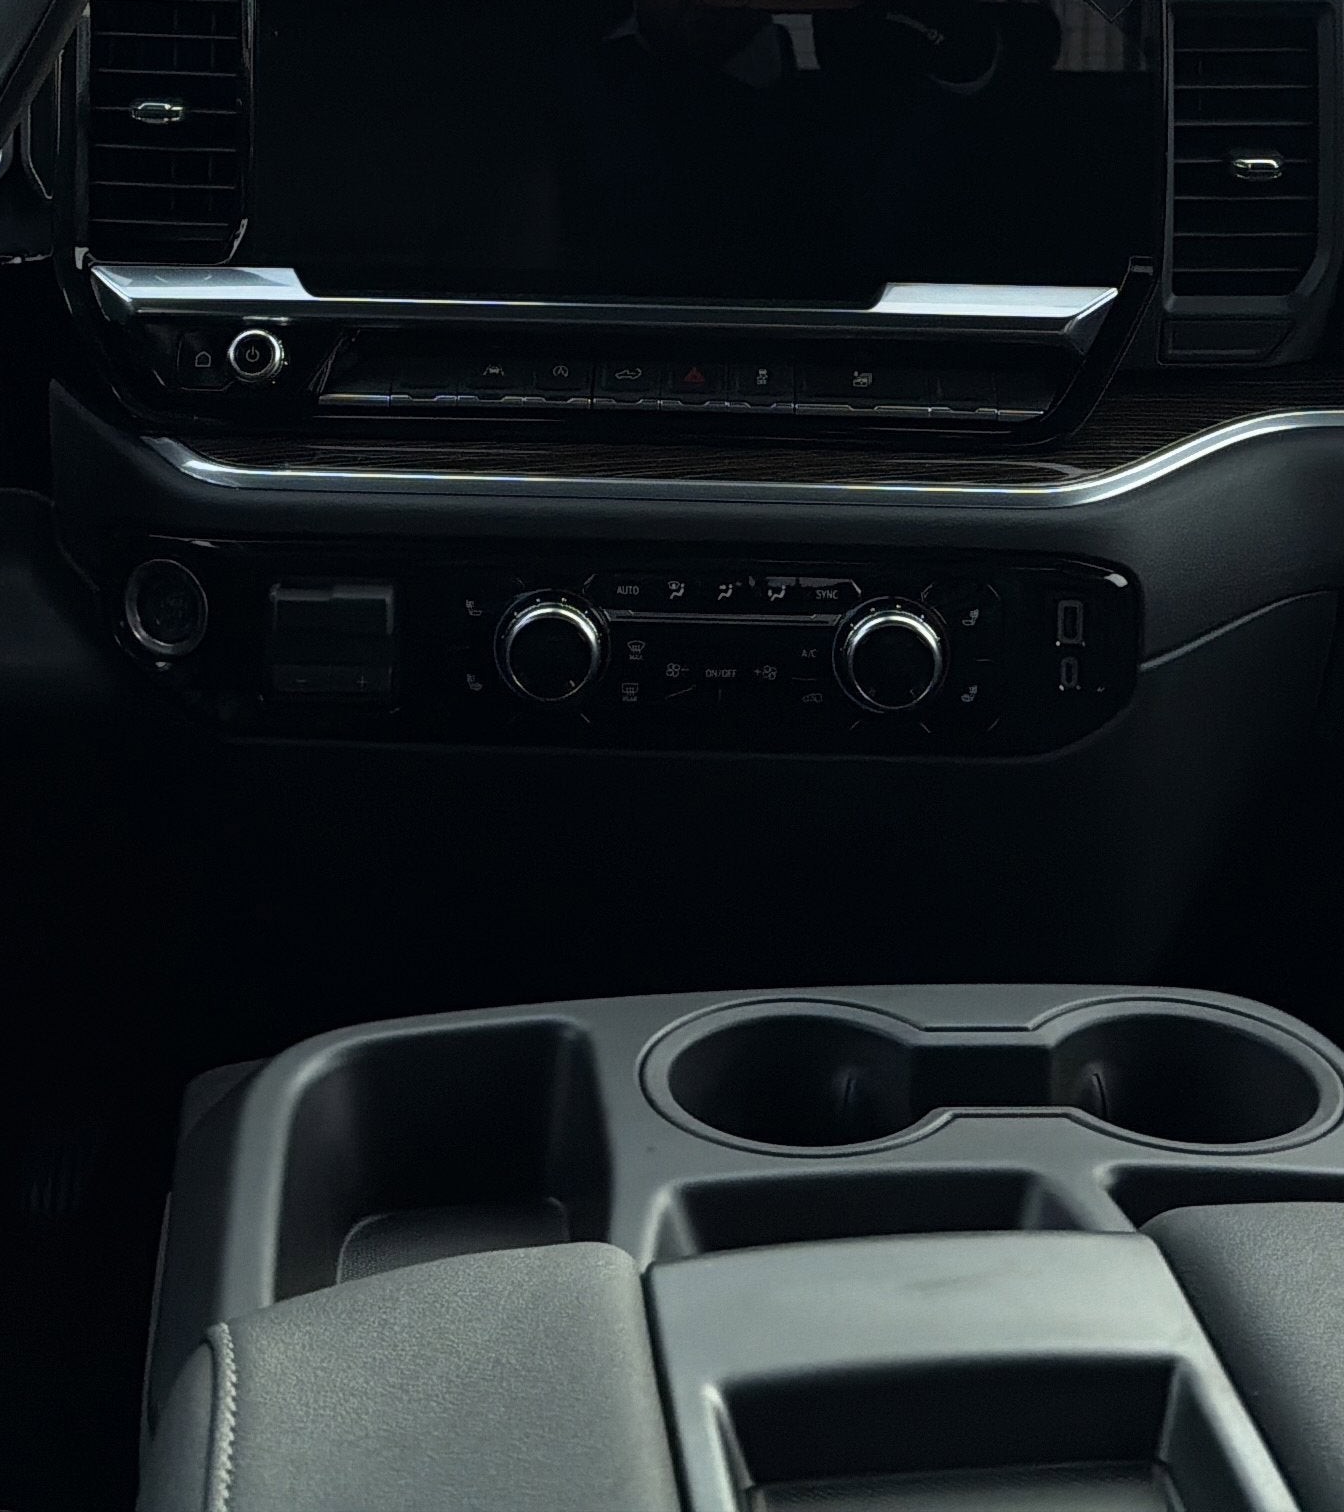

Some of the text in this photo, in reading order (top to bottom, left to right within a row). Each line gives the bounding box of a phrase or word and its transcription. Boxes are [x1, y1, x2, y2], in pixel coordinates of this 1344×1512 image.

[616, 585, 639, 596] AUTO
[815, 589, 838, 601] SYNC
[802, 648, 817, 659] A/C
[705, 669, 737, 679] ON/OFF
